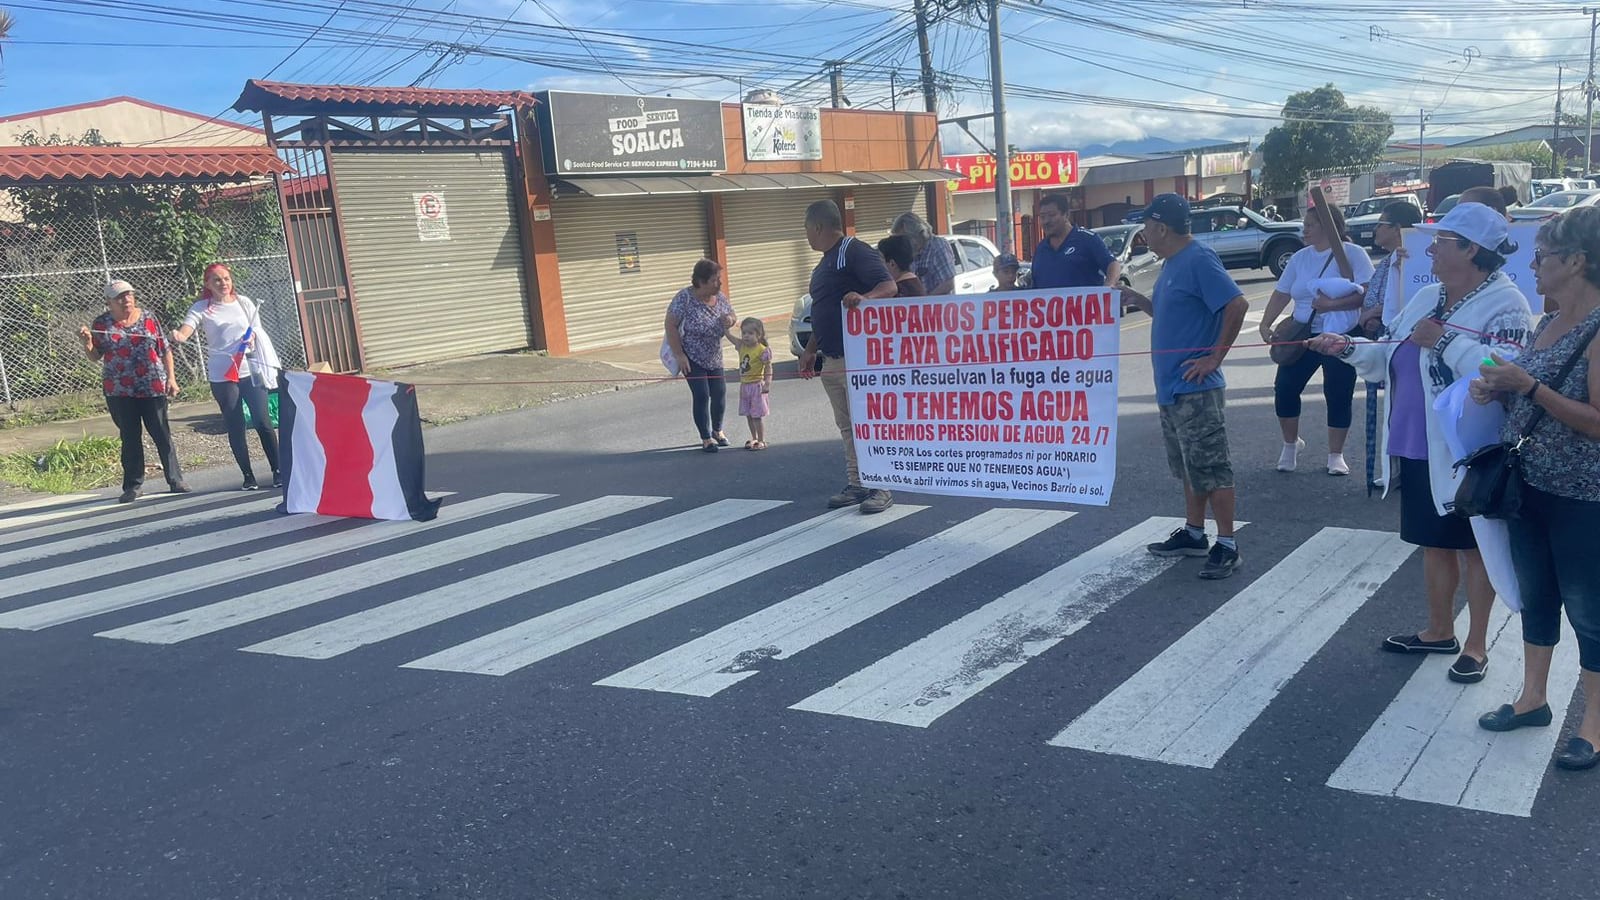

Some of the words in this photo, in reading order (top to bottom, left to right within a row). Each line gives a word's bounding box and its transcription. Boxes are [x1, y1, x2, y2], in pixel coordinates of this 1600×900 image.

[616, 119, 638, 129] FOOD
[646, 111, 677, 122] SERVICE
[747, 107, 772, 118] Tienda
[774, 108, 783, 118] de
[784, 109, 818, 120] Mascotas
[612, 127, 685, 156] SOALCA
[604, 160, 622, 168] Service
[976, 156, 988, 164] EL
[1034, 153, 1046, 162] DE
[969, 161, 1052, 184] PIOLO
[847, 301, 975, 336] OCUPAMOS
[982, 292, 1115, 330] PERSONAL
[866, 336, 895, 366] DE
[899, 335, 940, 365] AYA
[945, 328, 1094, 364] CALIFICADO
[851, 373, 877, 390] que
[882, 373, 905, 386] nos
[911, 368, 986, 385] Resuelvan
[991, 368, 1005, 384] la
[1009, 367, 1045, 388] fuga
[1051, 366, 1070, 384] de
[1075, 369, 1113, 388] agua
[866, 392, 898, 420] NO
[903, 390, 1014, 421] TENEMOS
[1020, 390, 1089, 422] AGUA
[855, 423, 870, 440] NO
[873, 423, 935, 441] TENEMOS
[938, 424, 999, 442] PRESION
[1003, 424, 1021, 443] DE
[1024, 425, 1065, 444] AGUA
[1071, 426, 1090, 445] 24
[1094, 426, 1110, 446] /7
[873, 446, 885, 456] NO
[886, 446, 897, 456] ES
[898, 447, 914, 457] POR
[916, 448, 932, 457] Los
[935, 449, 963, 458] cortes
[966, 449, 1023, 460] programados
[1025, 450, 1034, 459] ni
[1036, 451, 1052, 463] por
[1054, 451, 1097, 463] HORARIO
[906, 461, 944, 472] SIEMPRE
[946, 462, 966, 473] QUE
[969, 463, 982, 473] NO
[984, 463, 1034, 475] TENEMEOS
[861, 472, 881, 482] Desde
[883, 474, 891, 483] el
[892, 474, 902, 484] 03
[903, 476, 912, 485] de
[914, 476, 933, 486] abril
[935, 477, 969, 488] vivimos
[971, 478, 983, 488] sin
[984, 480, 1009, 491] agua,
[1011, 479, 1048, 492] Vecinos
[1051, 482, 1077, 494] Barrio
[1079, 484, 1088, 495] el
[1089, 485, 1105, 496] sol.
